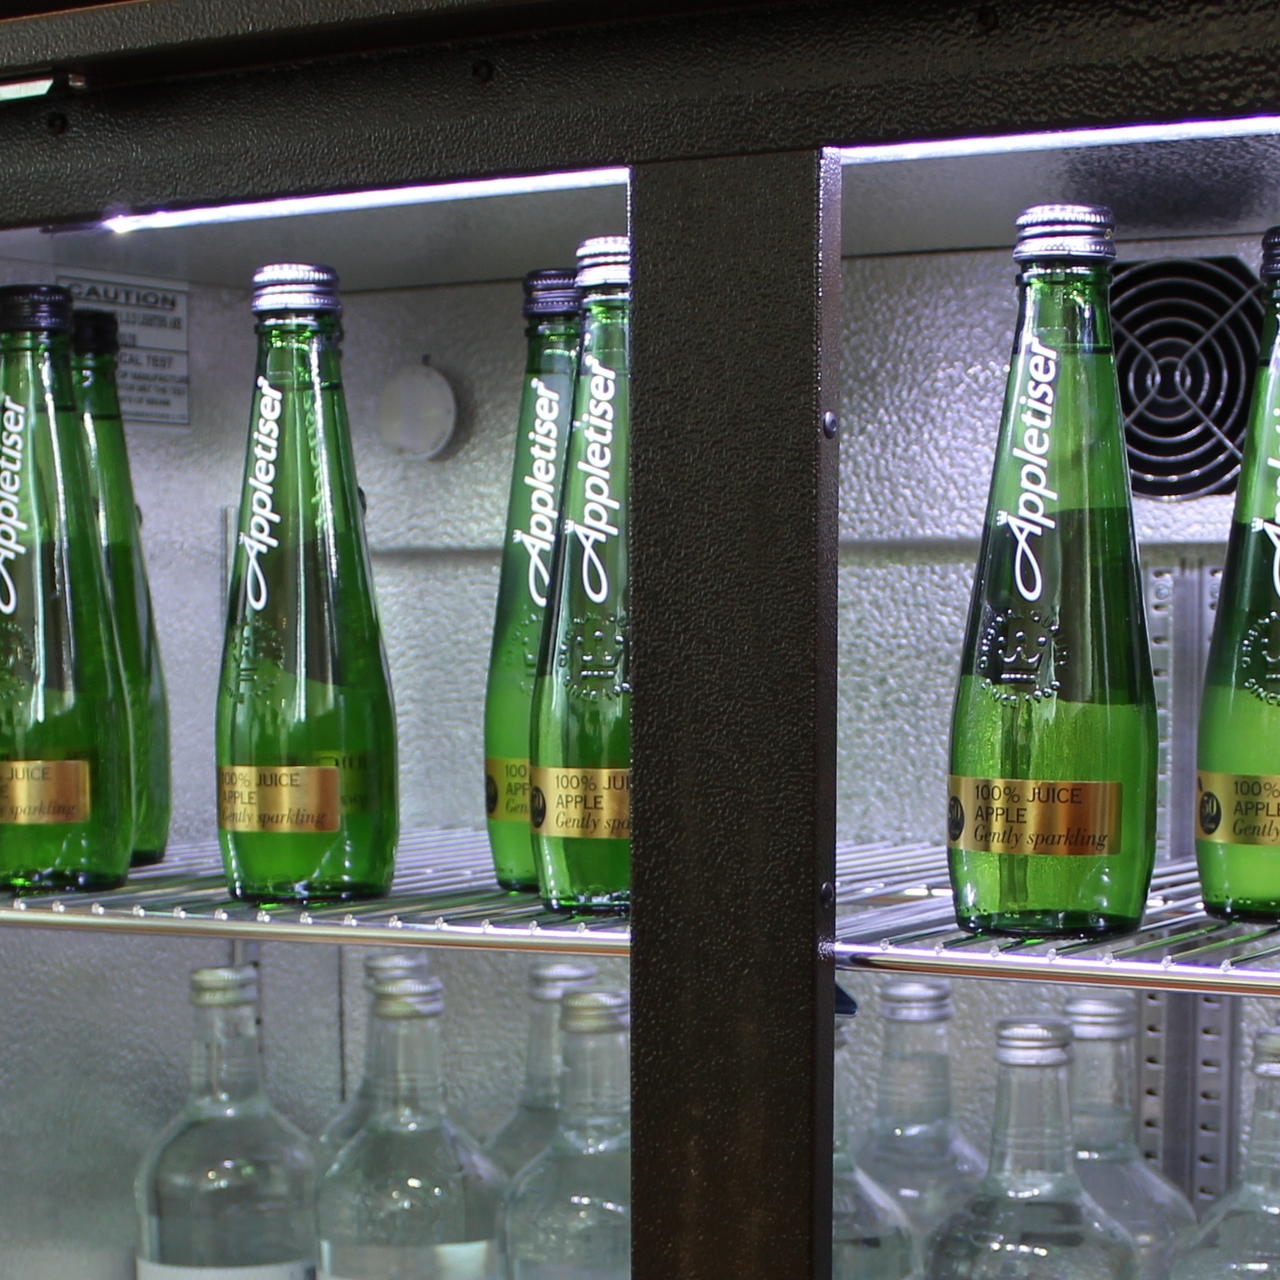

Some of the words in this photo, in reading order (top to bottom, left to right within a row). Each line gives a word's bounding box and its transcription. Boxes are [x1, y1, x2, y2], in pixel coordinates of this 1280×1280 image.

[70, 283, 176, 309] CAUTION
[1003, 335, 1059, 602] Appletiser
[568, 356, 621, 604] Appletiser
[240, 376, 283, 611] Appletiser
[515, 378, 561, 608] Appletiser
[7, 767, 52, 781] JUICE
[257, 773, 300, 788] JUICE
[555, 775, 597, 791] 100%
[974, 784, 1020, 804] 100%
[1027, 787, 1082, 804] JUICE
[1234, 780, 1280, 798] 100%
[555, 795, 604, 810] APPLE
[257, 807, 327, 828] sparkling
[555, 811, 600, 834] Gently
[974, 806, 1027, 824] APPLE
[974, 824, 1022, 849] Gently
[1026, 827, 1108, 851] sparkling
[1232, 820, 1280, 839] Gently
